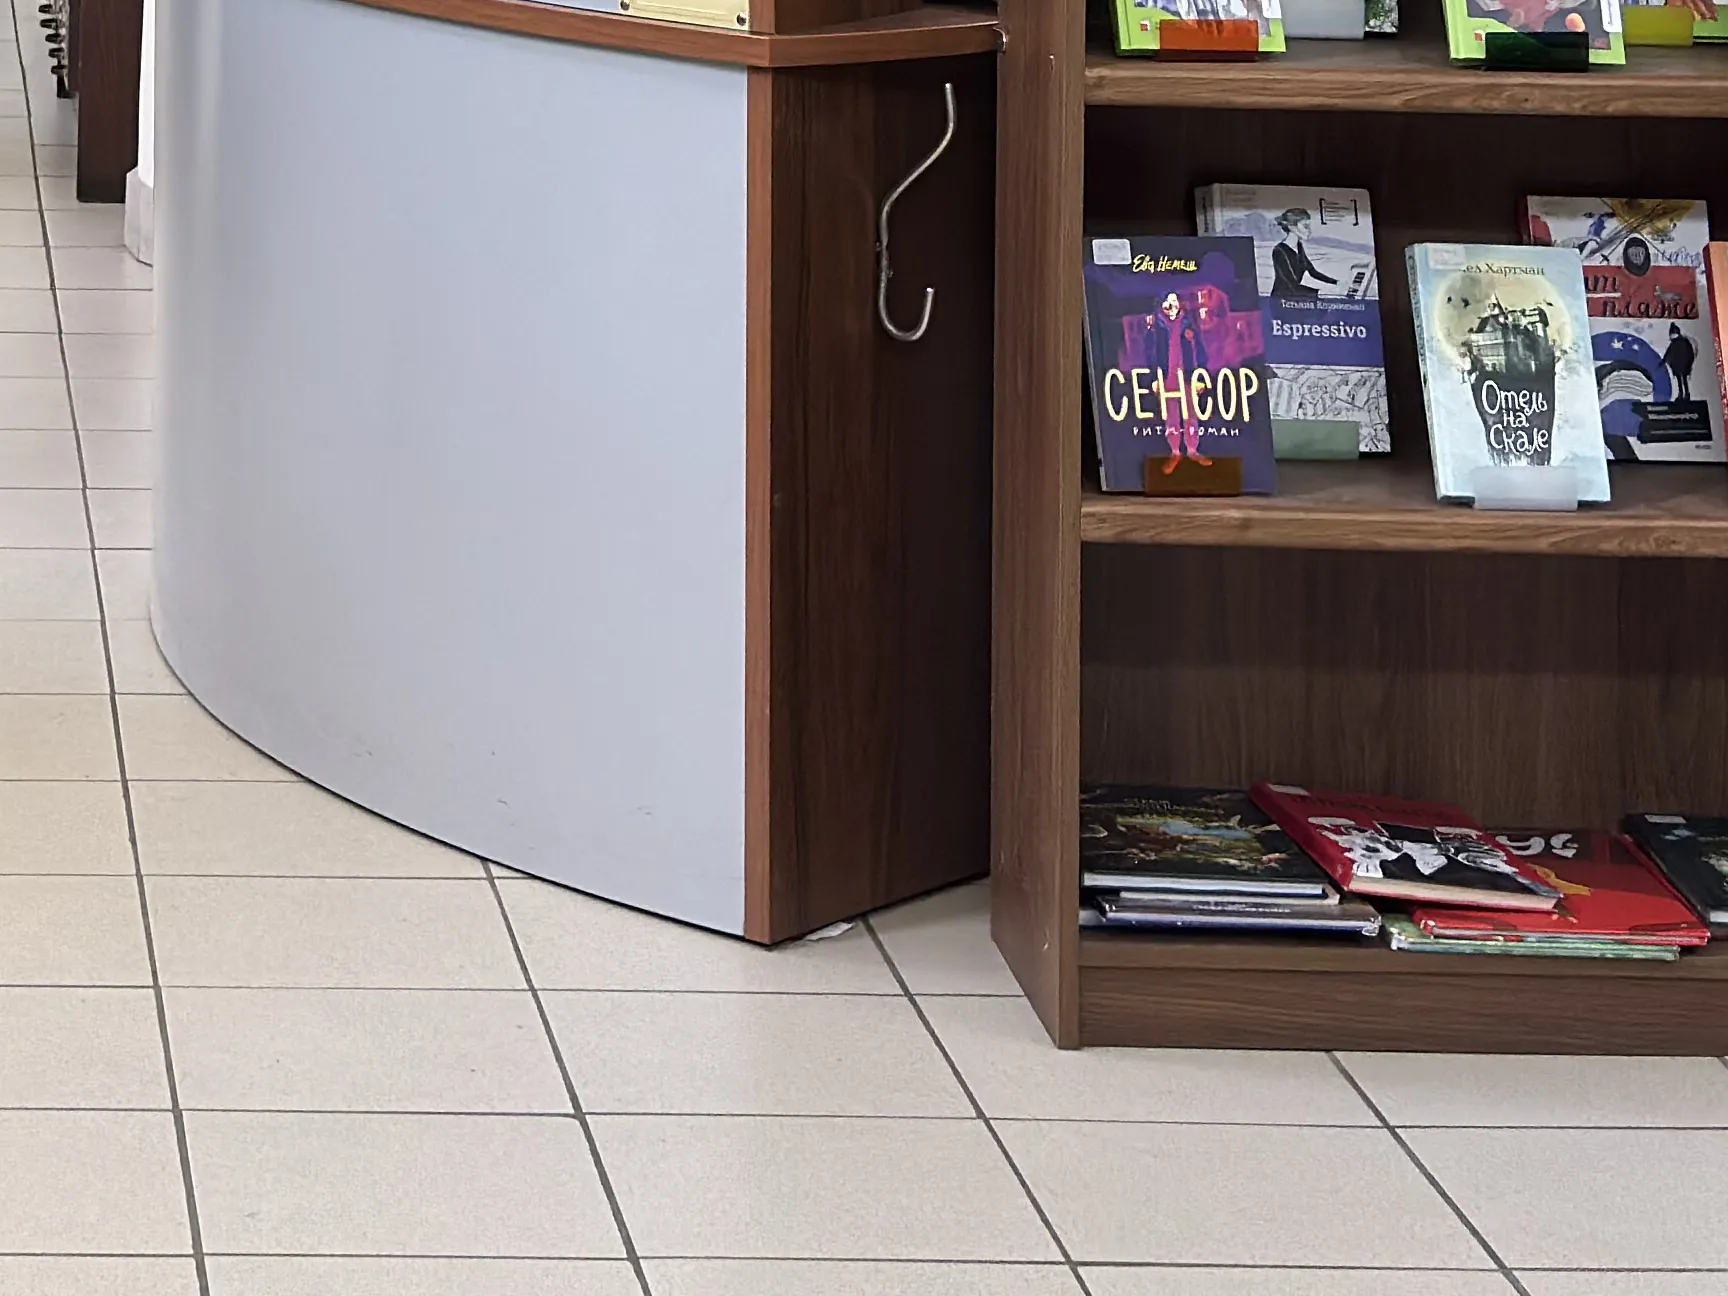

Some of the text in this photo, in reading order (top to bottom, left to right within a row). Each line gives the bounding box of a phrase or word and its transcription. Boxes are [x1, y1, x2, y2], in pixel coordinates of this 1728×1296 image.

[1272, 318, 1368, 340] Espressivo
[1102, 367, 1260, 424] СЕНСОР
[1480, 378, 1548, 412] Отель
[1502, 409, 1530, 429] на
[1488, 426, 1550, 456] Скале
